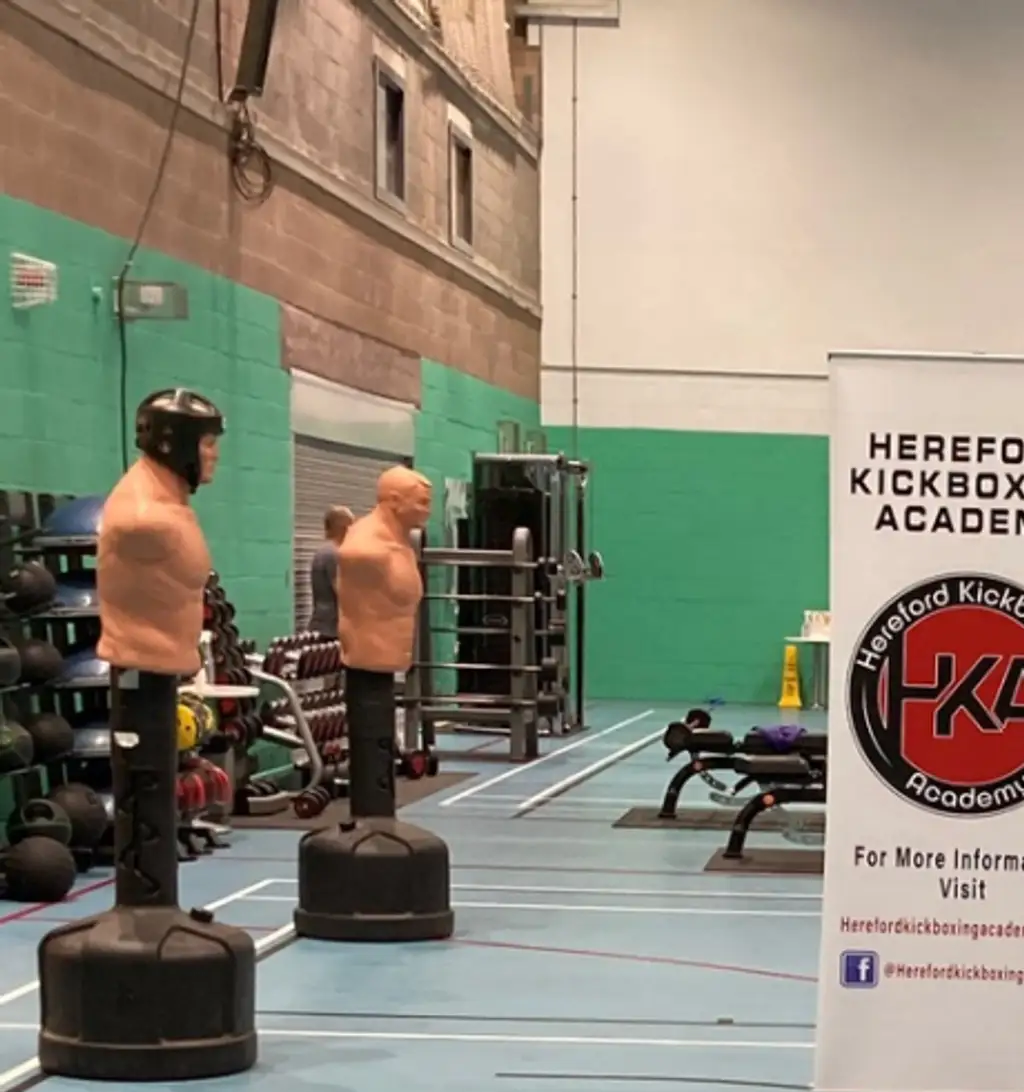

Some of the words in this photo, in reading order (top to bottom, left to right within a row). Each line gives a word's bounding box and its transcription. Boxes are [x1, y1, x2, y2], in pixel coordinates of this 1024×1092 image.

[857, 583, 950, 672] Hereford
[854, 845, 887, 868] For
[895, 846, 946, 870] More
[939, 878, 987, 900] Visit
